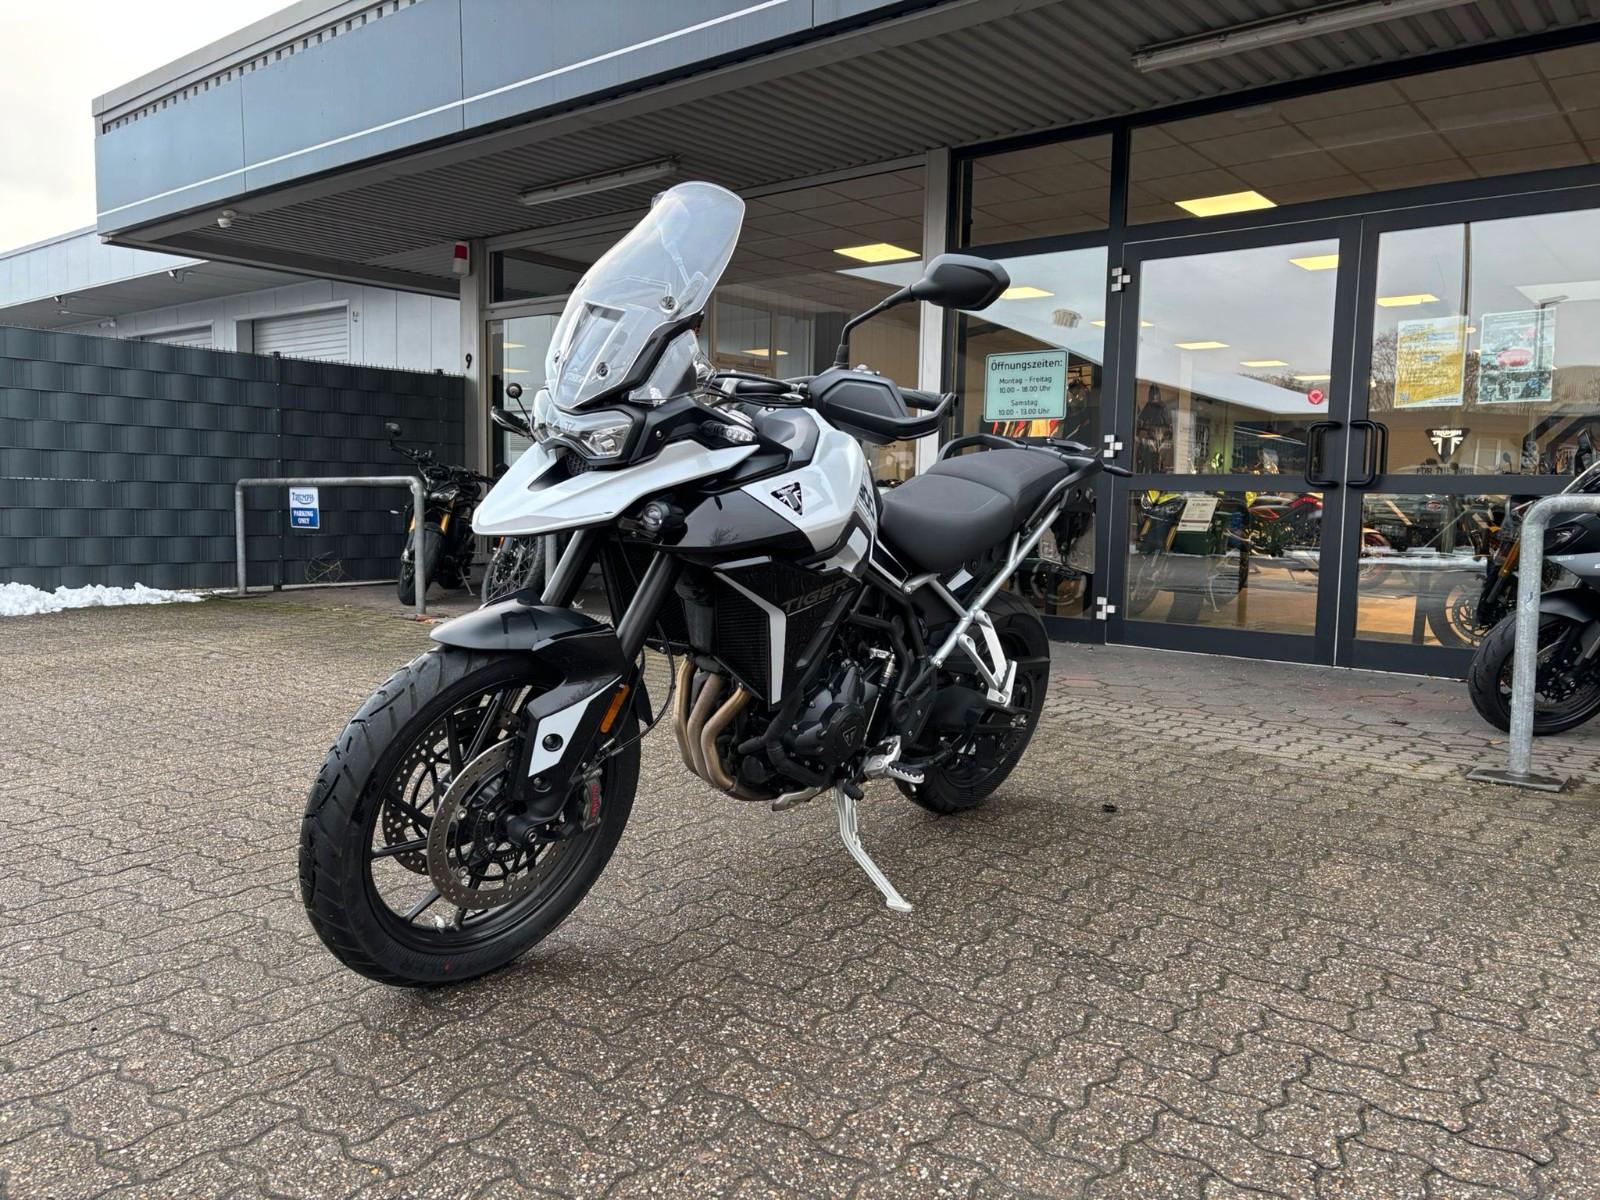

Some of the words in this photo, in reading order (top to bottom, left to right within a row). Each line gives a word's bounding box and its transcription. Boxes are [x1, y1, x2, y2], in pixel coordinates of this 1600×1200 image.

[465, 353, 473, 369] 9
[990, 360, 1063, 371] Öffnungszeiten:
[1029, 376, 1052, 384] Freitag
[999, 386, 1015, 394] 10.00
[1010, 399, 1038, 407] Samstag
[998, 408, 1015, 416] 10.00
[1038, 407, 1050, 415] Uhr
[781, 577, 850, 614] TIGER
